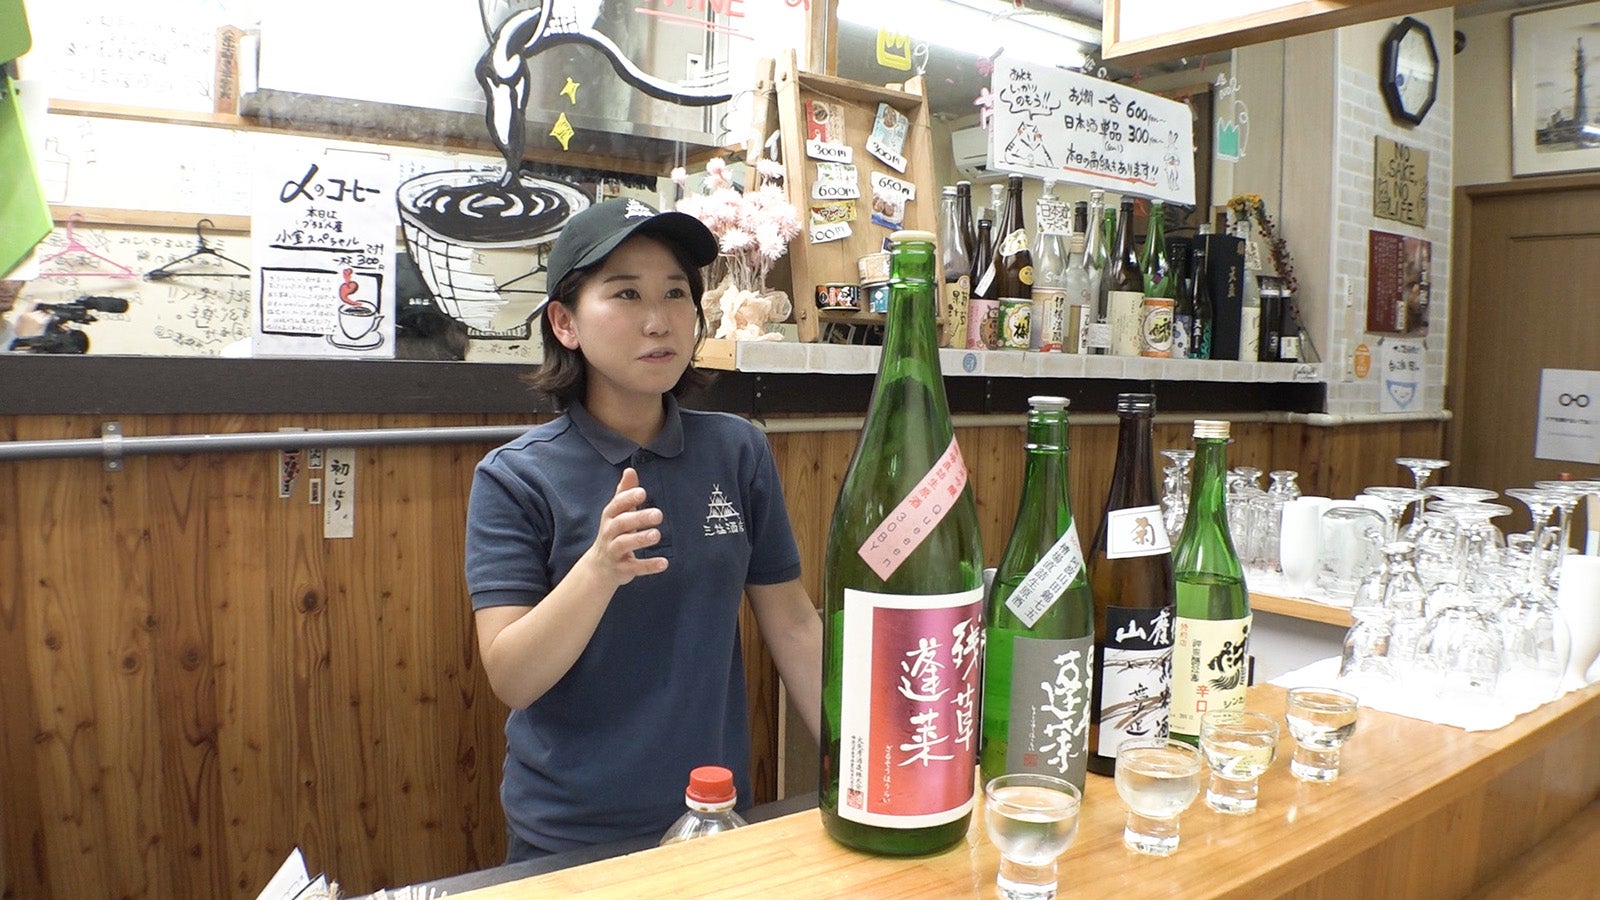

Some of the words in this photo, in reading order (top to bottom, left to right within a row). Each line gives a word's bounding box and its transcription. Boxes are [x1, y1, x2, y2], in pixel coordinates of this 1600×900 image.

[306, 206, 339, 219] 本日は
[1195, 684, 1210, 713] 辛口
